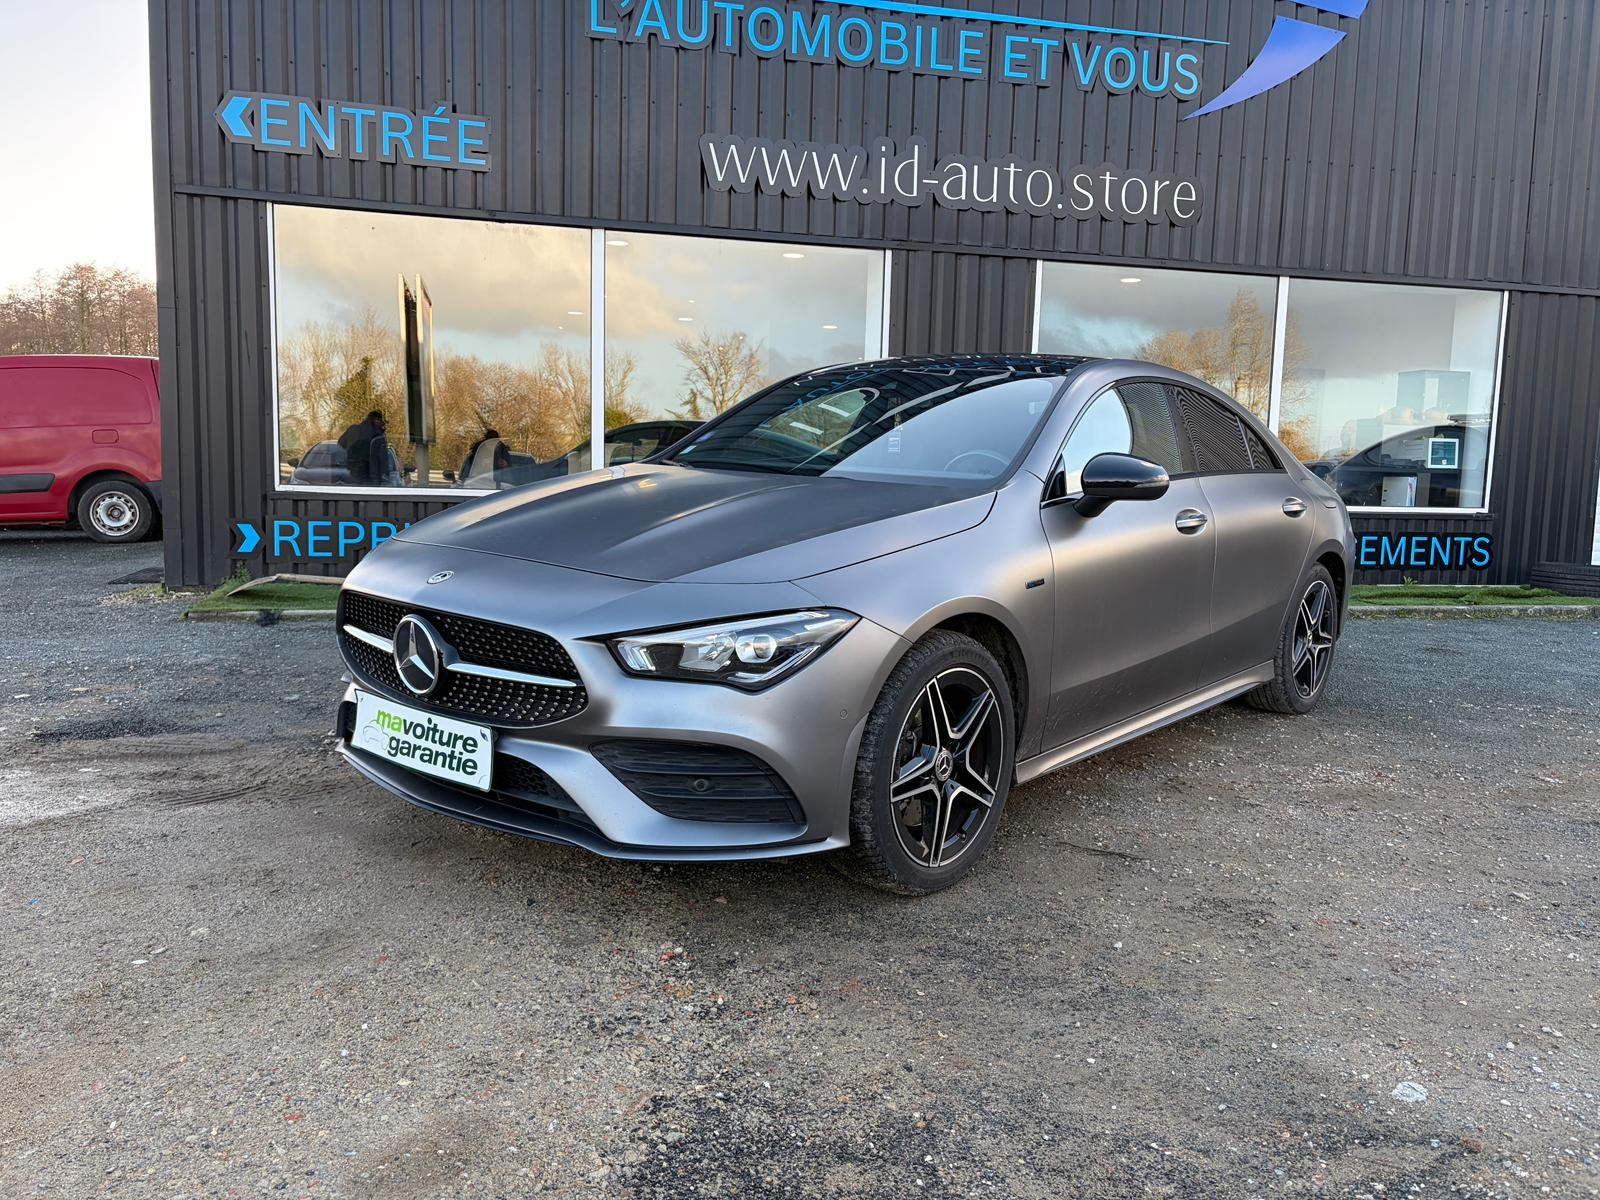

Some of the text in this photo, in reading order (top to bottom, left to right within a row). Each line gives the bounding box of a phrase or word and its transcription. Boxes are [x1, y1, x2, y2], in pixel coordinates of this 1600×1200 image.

[590, 0, 1200, 96] L'AUTOMOBILE ET VOUS
[260, 97, 487, 166] ENTRÉE
[708, 142, 1197, 219] www.id-auto.store
[273, 520, 412, 557] REPR
[1355, 535, 1490, 567] EMENTS
[386, 734, 478, 776] garantie
